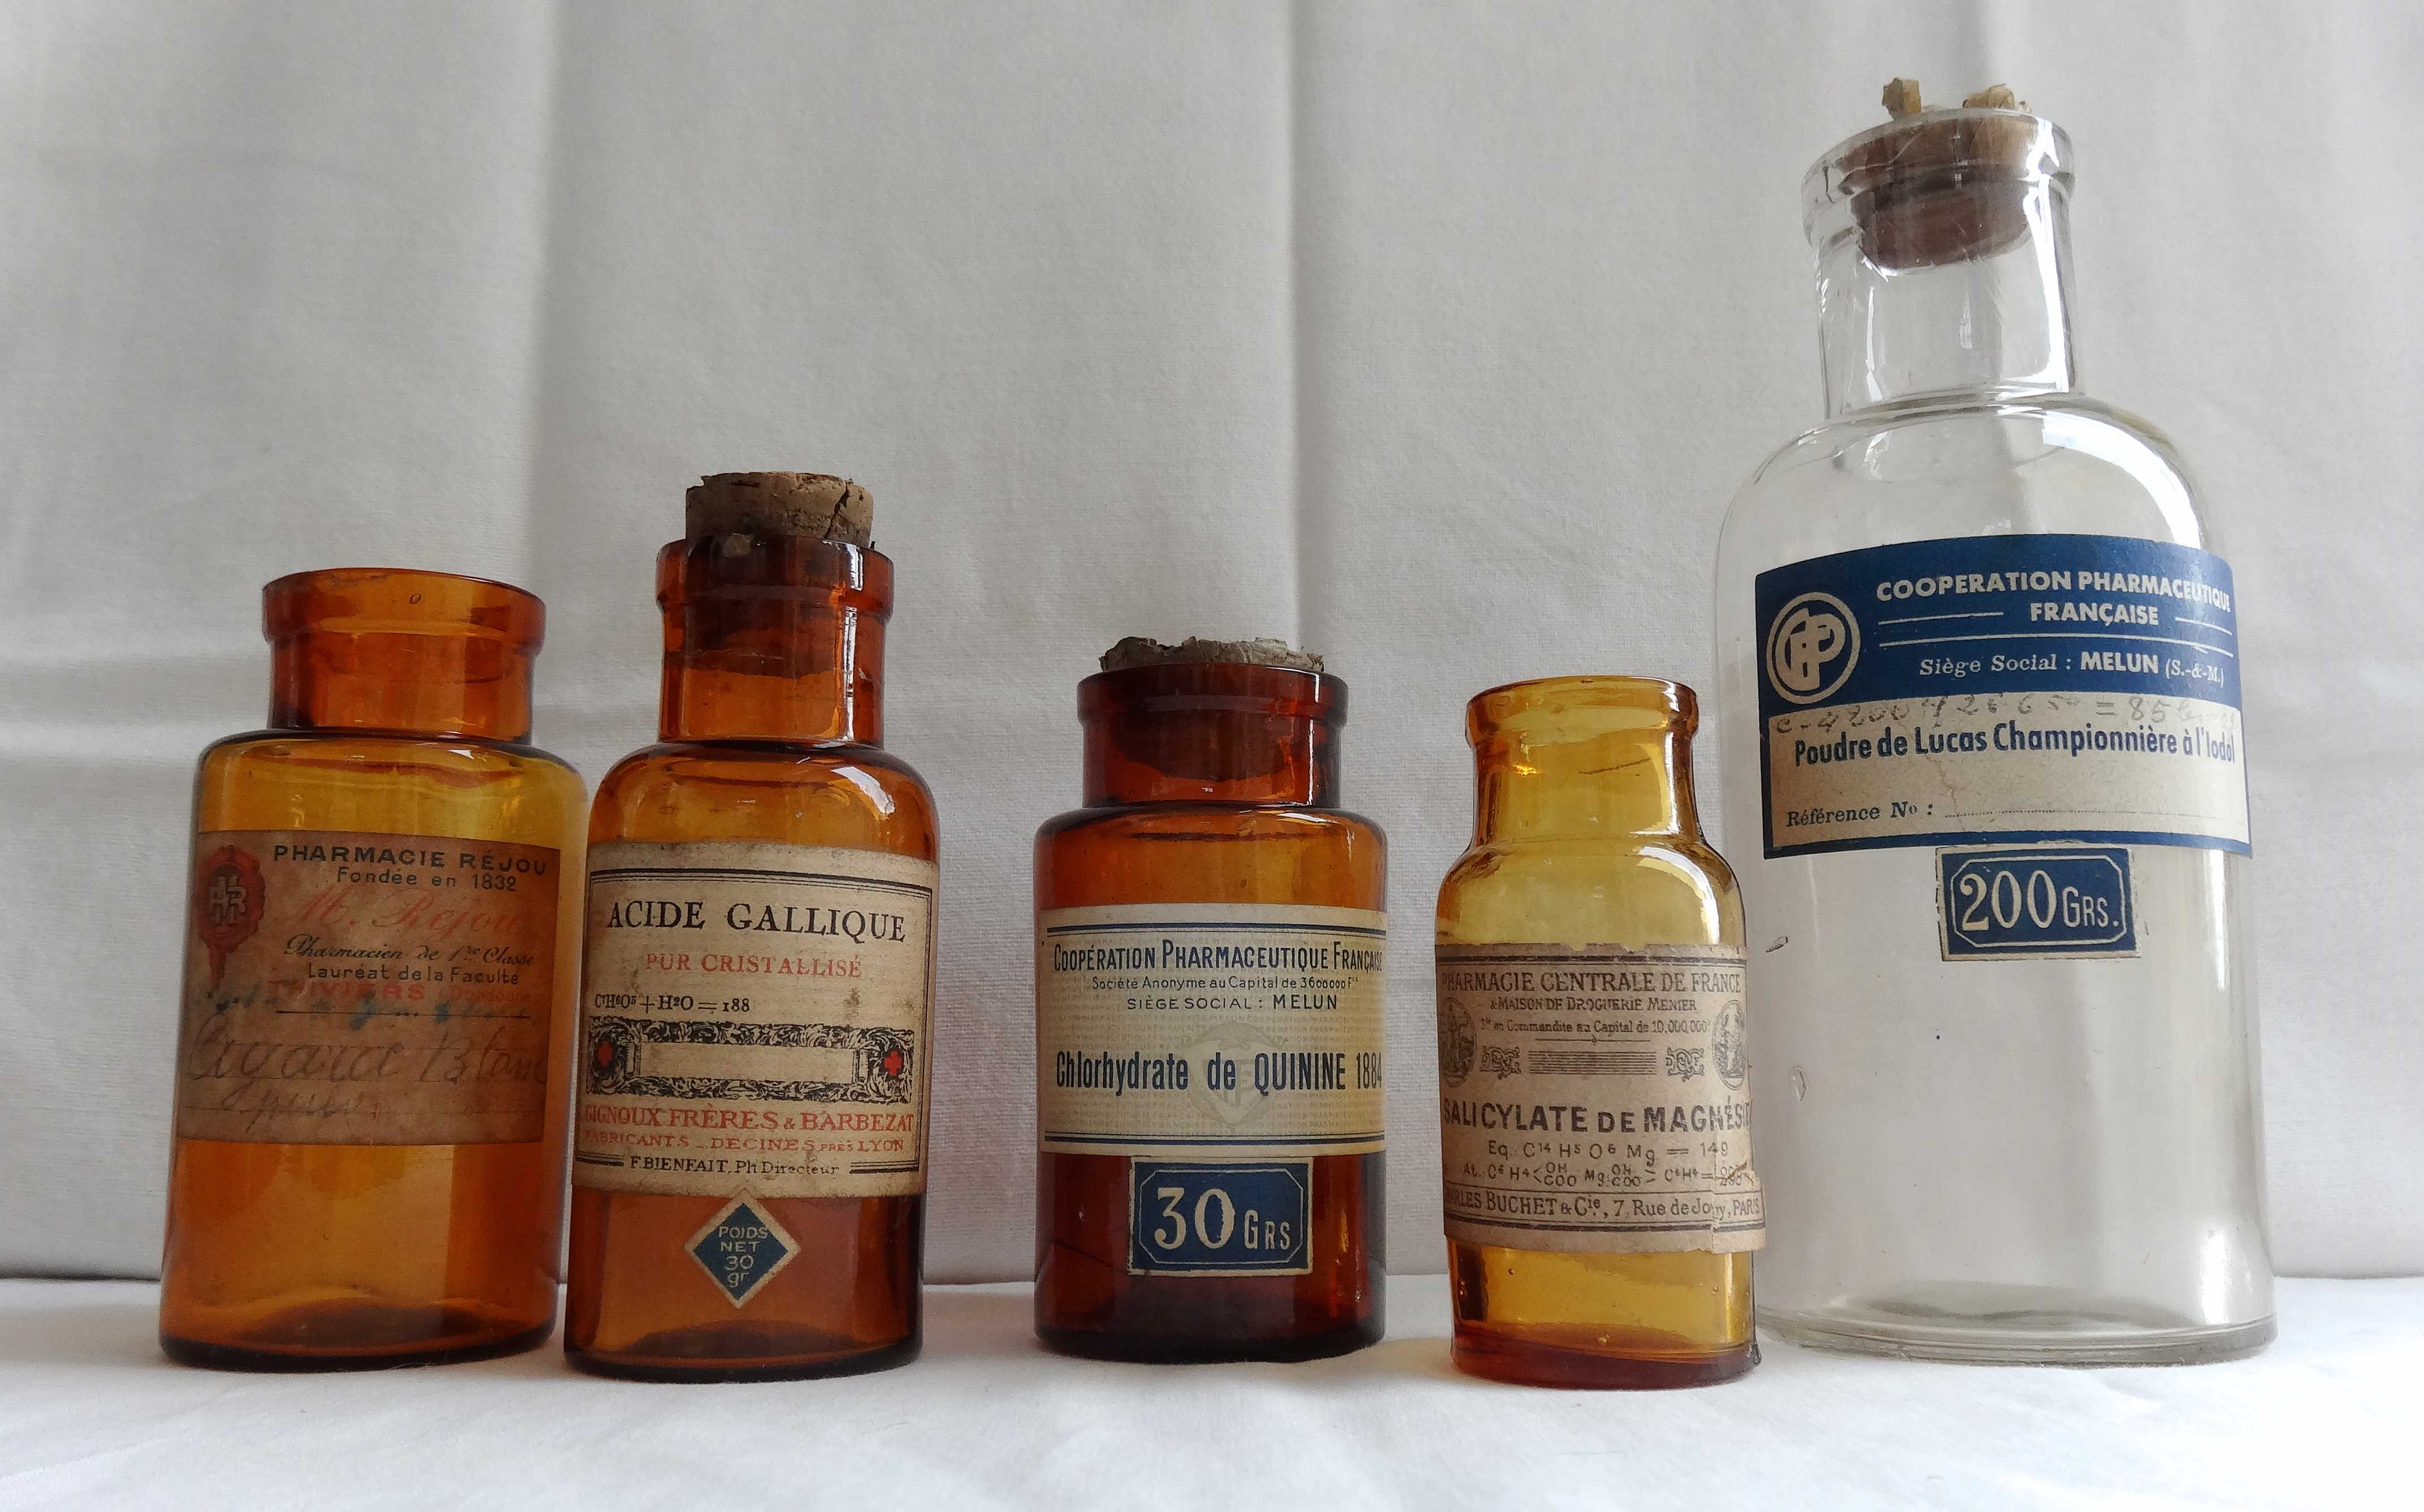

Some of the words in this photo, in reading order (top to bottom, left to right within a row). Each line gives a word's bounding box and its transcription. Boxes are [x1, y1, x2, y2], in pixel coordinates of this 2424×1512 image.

[1876, 571, 2071, 601] COOPERATION
[2078, 571, 2231, 613] PHARMACEUTIQUE
[2030, 602, 2159, 627] FRANÇAISE
[1920, 657, 1981, 678] Siège
[1991, 654, 2057, 672] Social
[2080, 651, 2159, 674] MELUN
[1794, 731, 1872, 767] Poudre
[1877, 727, 1908, 758] de
[1914, 727, 1987, 755] Lucas
[1992, 720, 2178, 758] Championnière
[2182, 727, 2193, 755] à
[1786, 806, 1880, 828] Référence
[274, 844, 445, 868] PHARMACIE
[458, 849, 547, 876] RÉJOU
[337, 866, 417, 886] Fondée
[431, 875, 457, 888] en
[471, 874, 517, 892] 1832
[1959, 870, 2057, 931] 200
[606, 900, 706, 930] ACIDE
[727, 903, 905, 944] GALLIQUE
[284, 933, 404, 959] Pharmacien
[1053, 943, 1156, 972] COOPÉRATION
[1162, 939, 1329, 972] PHARMACEUTIQUE
[1333, 941, 1383, 974] FRANÇAISE
[308, 962, 390, 980] Lauréat
[398, 964, 422, 981] de
[427, 965, 444, 982] la
[645, 953, 691, 971] PUR
[701, 953, 862, 978] CRISTALLISÉ
[1091, 975, 1139, 990] Société
[1142, 975, 1206, 991] Anonyme
[1209, 980, 1226, 989] au
[1228, 975, 1278, 990] Capital
[1281, 977, 1298, 989] de
[1540, 971, 1656, 993] CENTRALE
[1660, 971, 1686, 993] DE
[1690, 972, 1742, 993] FRANCE
[1127, 994, 1180, 1010] SIÈGE
[1184, 997, 1253, 1010] SOCIAL
[1273, 993, 1338, 1010] MELUN
[1546, 997, 1563, 1010] DE
[1646, 997, 1698, 1011] MENIER
[1594, 1020, 1633, 1037] Capital
[1636, 1020, 1650, 1033] de
[1056, 1050, 1189, 1097] Chlorhydrate
[1207, 1052, 1237, 1091] de
[1254, 1052, 1346, 1097] QUININE
[1356, 1052, 1383, 1089] 1884
[584, 1103, 665, 1128] GIGNOUX
[669, 1102, 778, 1130] FRÈRES
[783, 1116, 795, 1130] &
[800, 1111, 914, 1132] BARBEZAT
[1443, 1097, 1589, 1133] SALICYLATE
[1597, 1111, 1636, 1133] DE
[857, 1139, 905, 1153] LYON
[735, 1160, 757, 1175] Ph
[761, 1160, 840, 1175] Directeur
[1486, 1190, 1558, 1215] BUCHET
[1632, 1199, 1667, 1216] Rue
[1670, 1198, 1689, 1216] de
[1732, 1197, 1760, 1216] PARIS
[1154, 1185, 1236, 1250] 30
[718, 1225, 769, 1240] POIDS
[720, 1241, 760, 1253] NET
[724, 1254, 755, 1271] 30
[726, 1271, 750, 1288] gr
